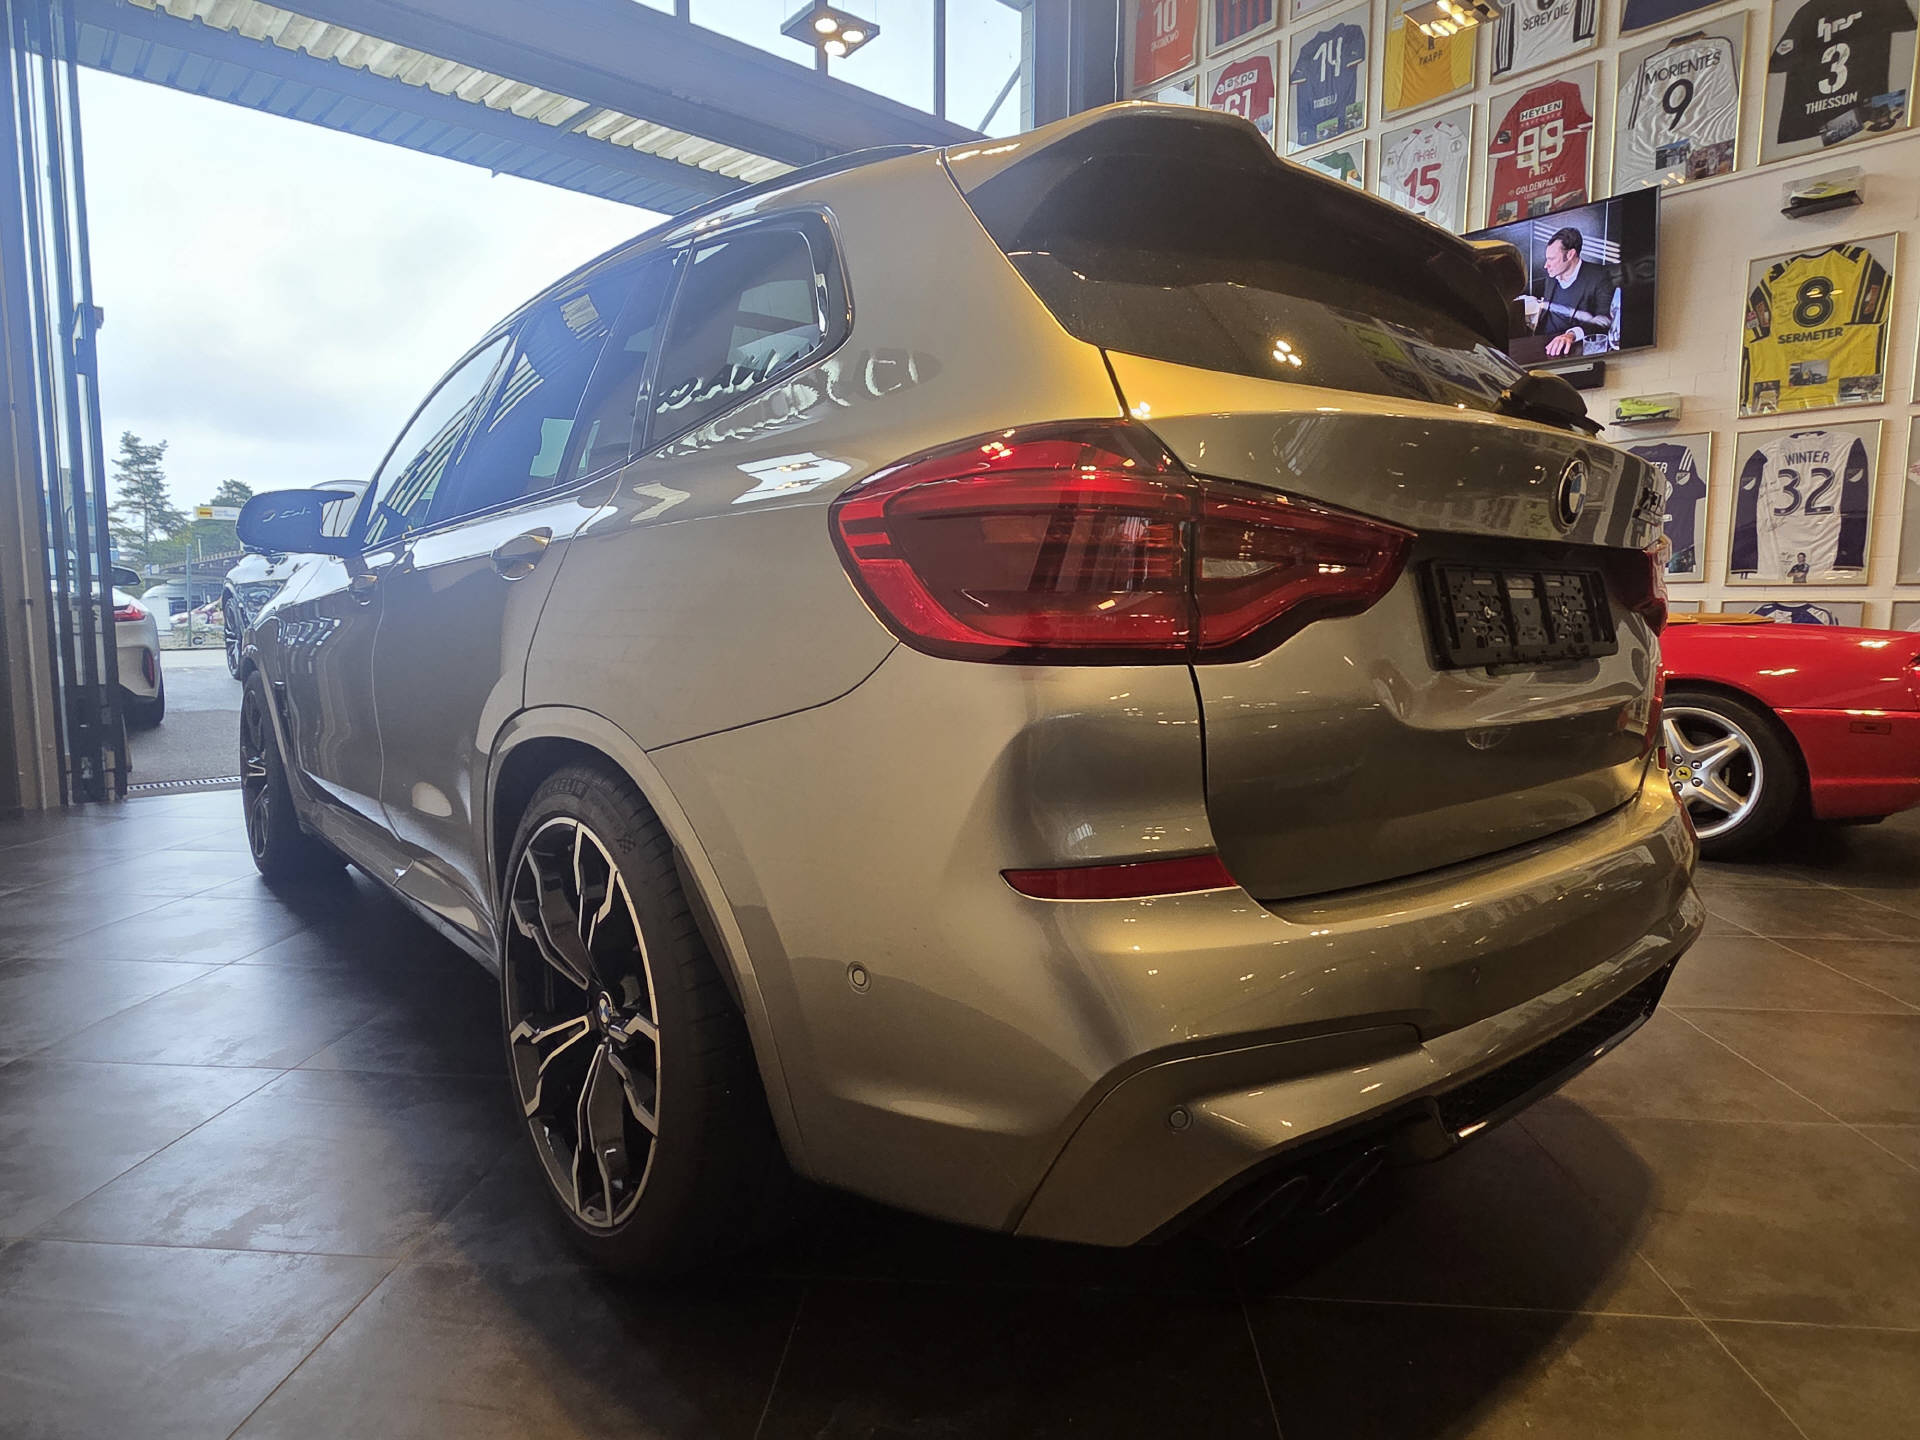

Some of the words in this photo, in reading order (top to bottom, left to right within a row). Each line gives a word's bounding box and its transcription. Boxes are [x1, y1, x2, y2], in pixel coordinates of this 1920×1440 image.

[1153, 0, 1177, 37] 10
[1522, 10, 1553, 31] SEREY
[1553, 3, 1570, 20] DIE
[1313, 36, 1343, 82] 14
[1645, 48, 1722, 85] MORIENTES
[1818, 42, 1850, 94] 3
[1521, 101, 1561, 121] HEYLEN
[1662, 78, 1694, 131] 9
[1805, 91, 1858, 115] THIESSON
[1516, 118, 1565, 170] 99
[1403, 163, 1442, 209] 15
[1528, 162, 1553, 179] FEY
[1793, 276, 1834, 328] 8
[1778, 327, 1844, 344] SERMETER
[1785, 450, 1831, 466] WINTER
[1774, 467, 1836, 516] 32
